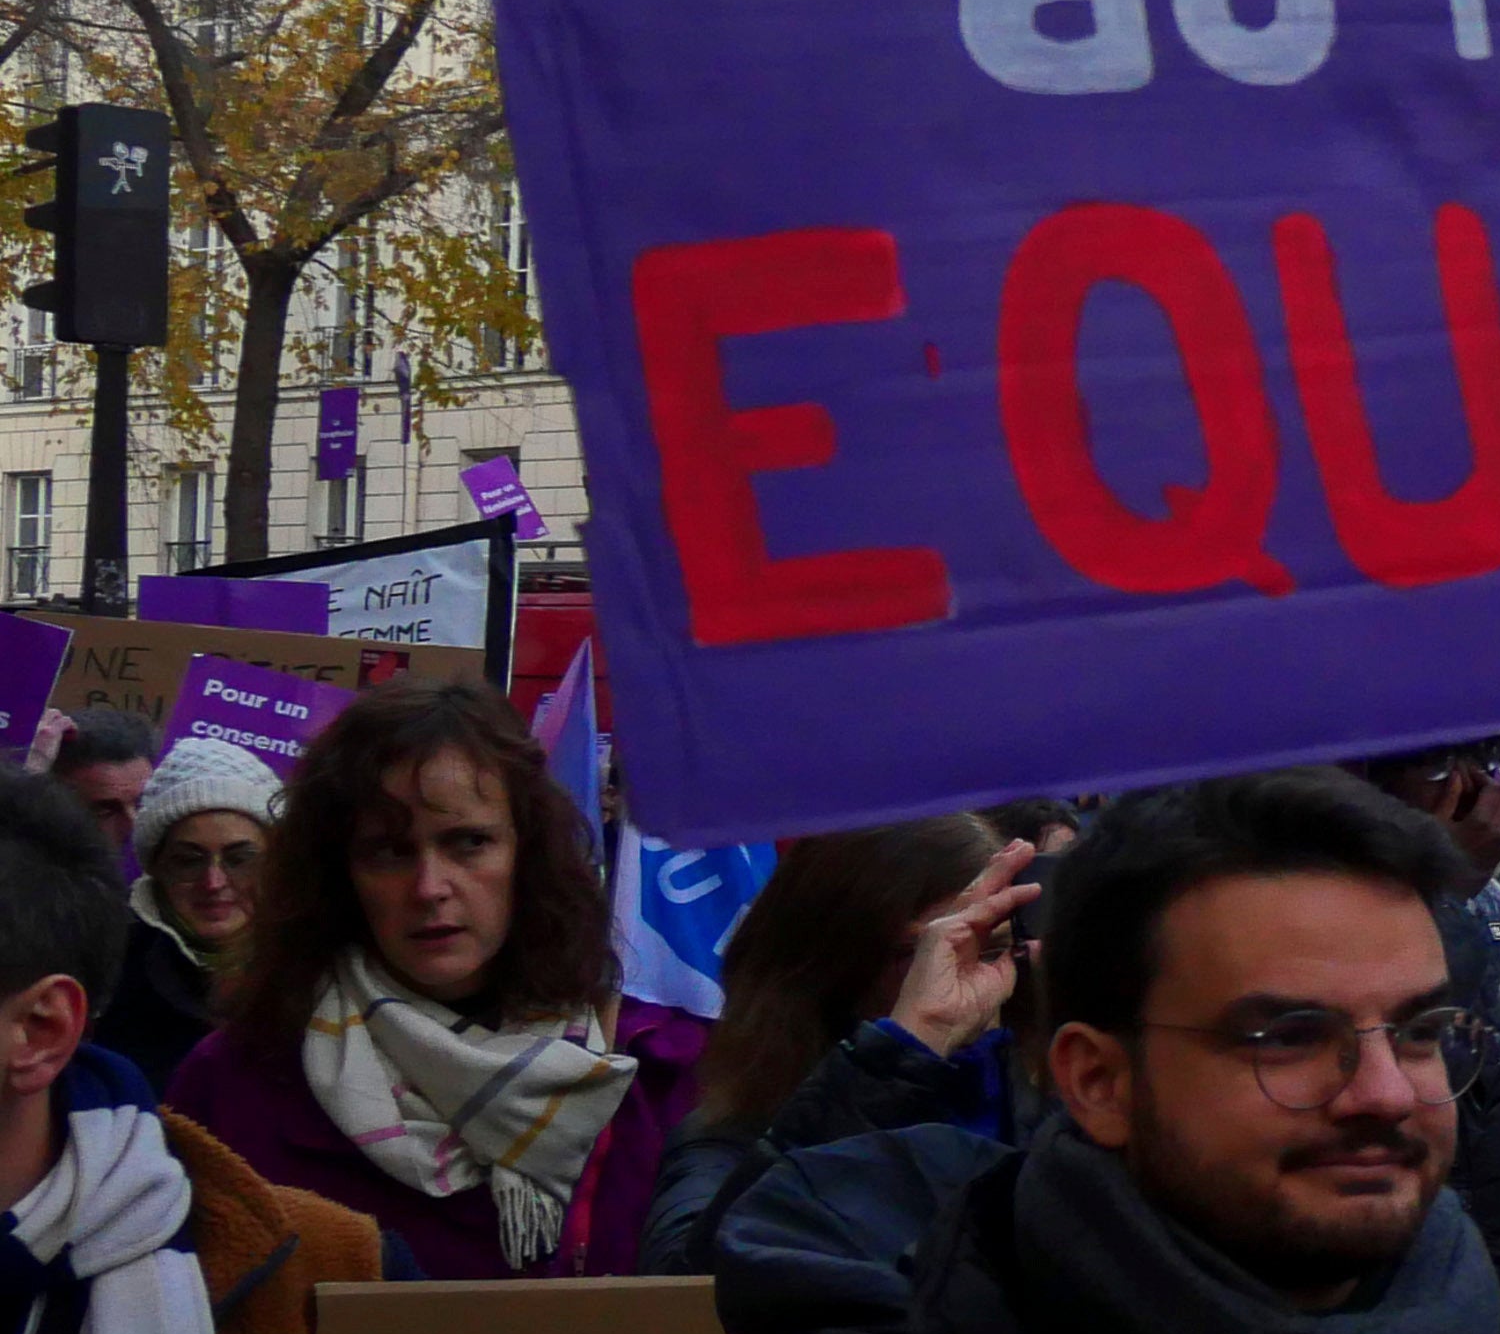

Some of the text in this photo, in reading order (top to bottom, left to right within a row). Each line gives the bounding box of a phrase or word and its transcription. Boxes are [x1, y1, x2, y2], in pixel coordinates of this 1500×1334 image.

[364, 569, 442, 612] NAÎT
[203, 678, 308, 720] Pour un
